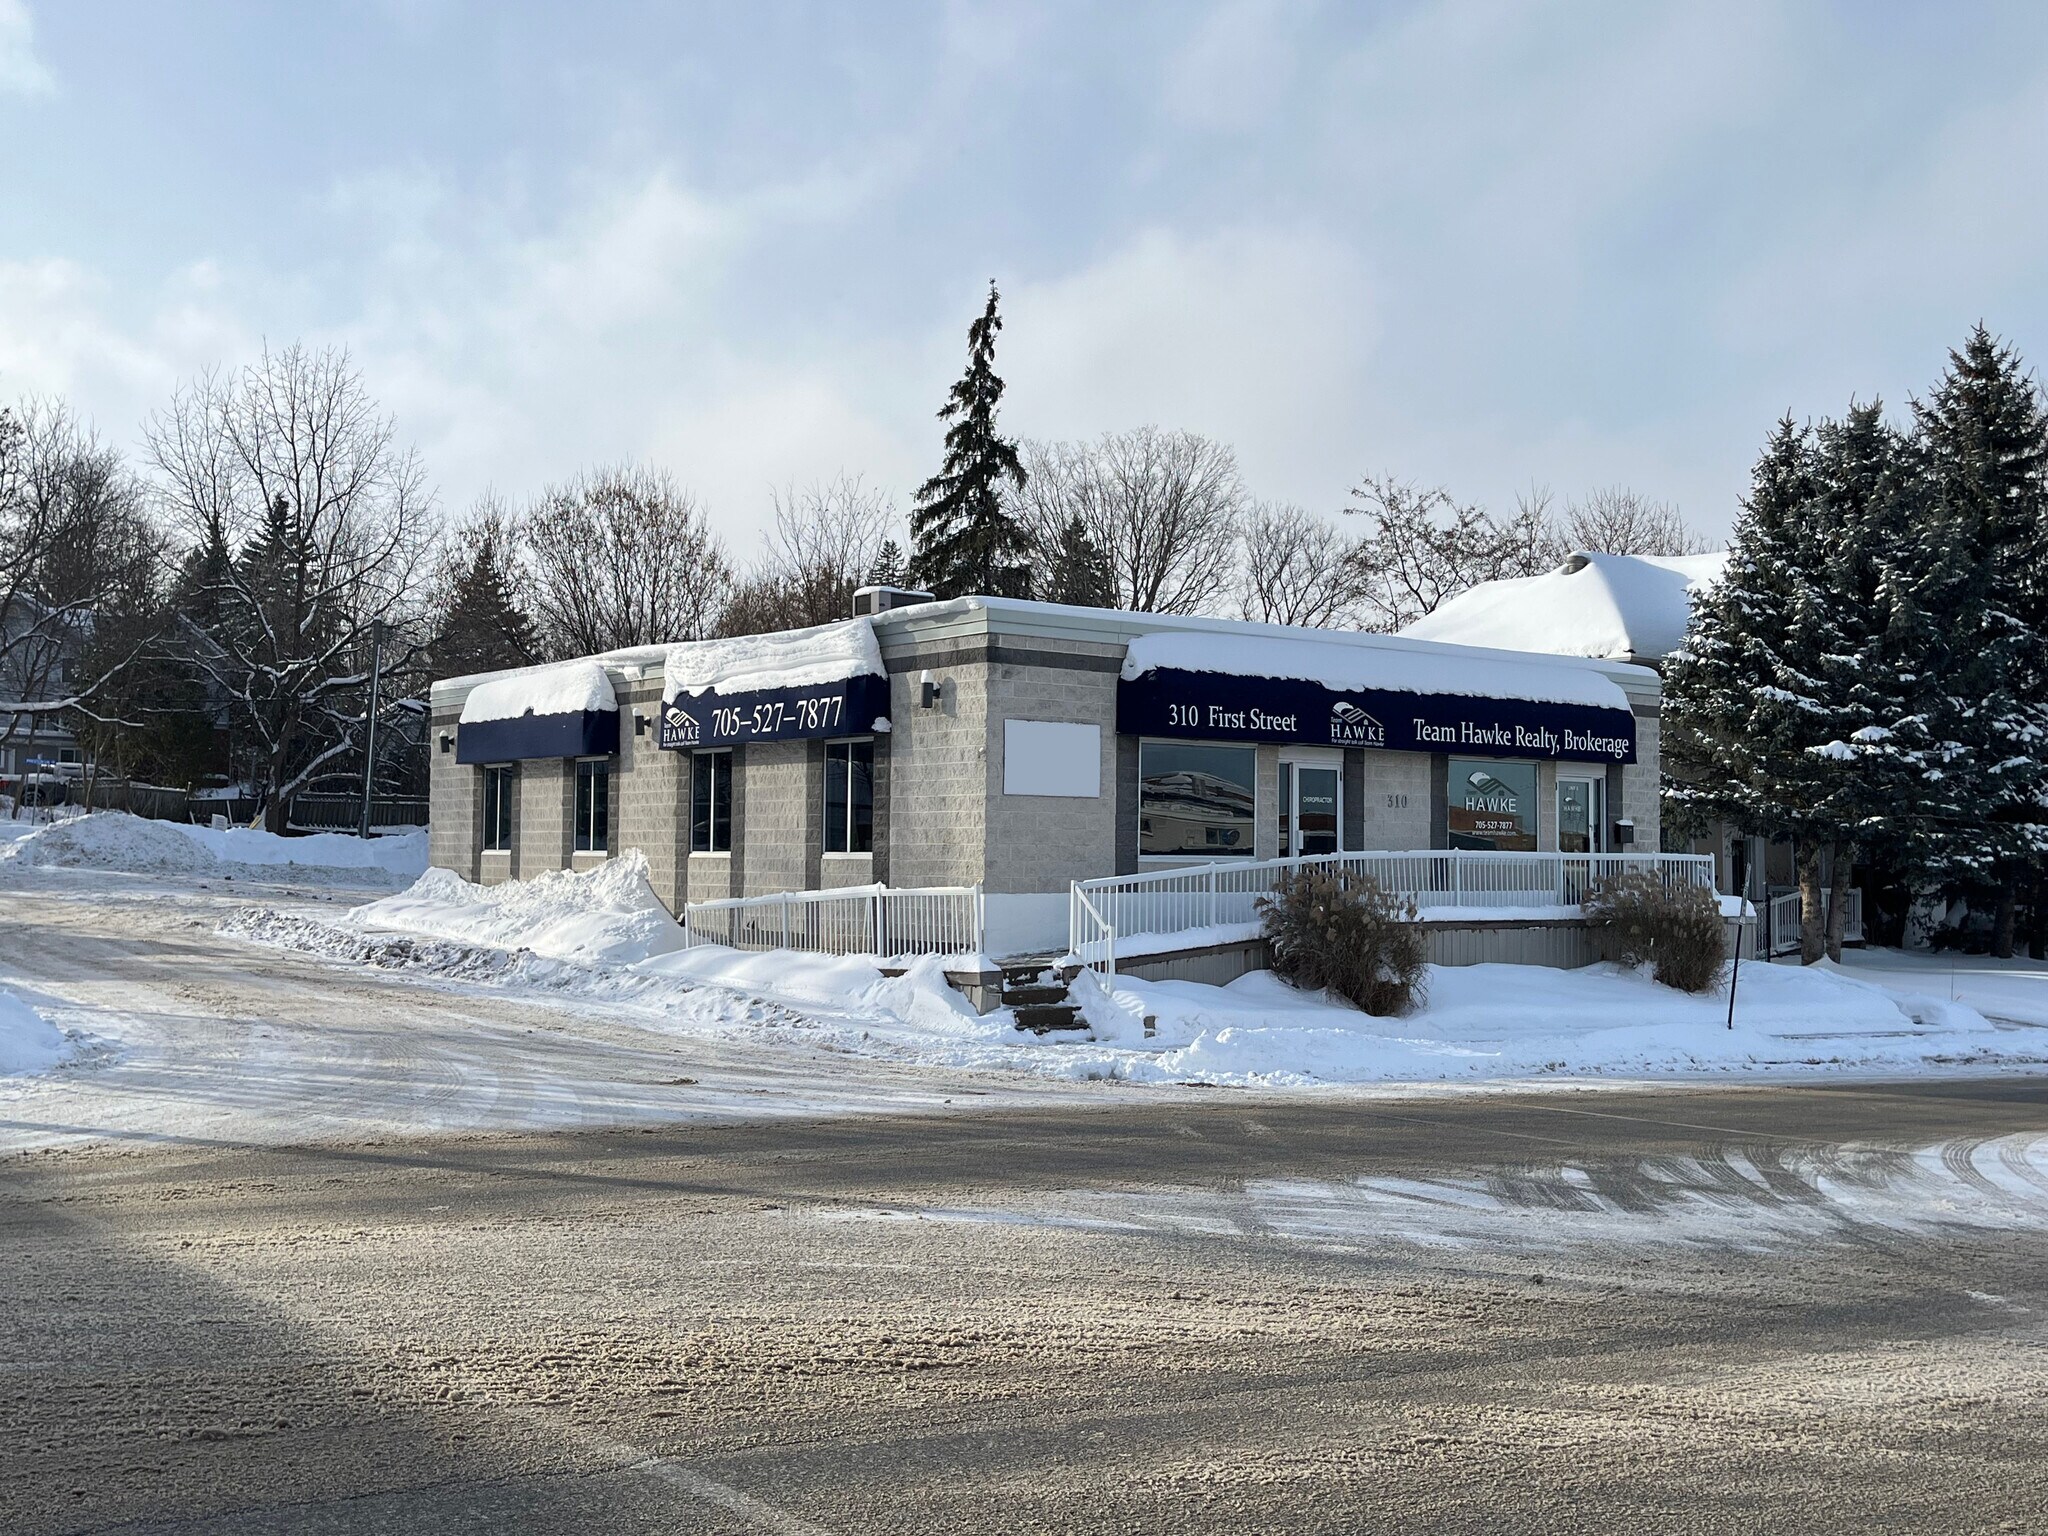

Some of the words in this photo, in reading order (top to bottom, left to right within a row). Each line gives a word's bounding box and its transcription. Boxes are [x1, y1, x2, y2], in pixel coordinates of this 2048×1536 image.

[712, 696, 843, 738] 705-527-7877
[1168, 704, 1199, 727] 310
[1208, 705, 1246, 729] First
[1250, 708, 1298, 732] Street
[663, 726, 700, 742] HAWKE
[1331, 724, 1384, 741] HAWKE
[1413, 718, 1457, 743] Team
[1460, 721, 1512, 746] Hawke
[1515, 725, 1560, 755] Realty,
[1564, 729, 1629, 759] Brokerage
[1387, 794, 1407, 809] 310
[1465, 796, 1517, 812] HAWKE
[1475, 820, 1513, 830] 705-527-7877
